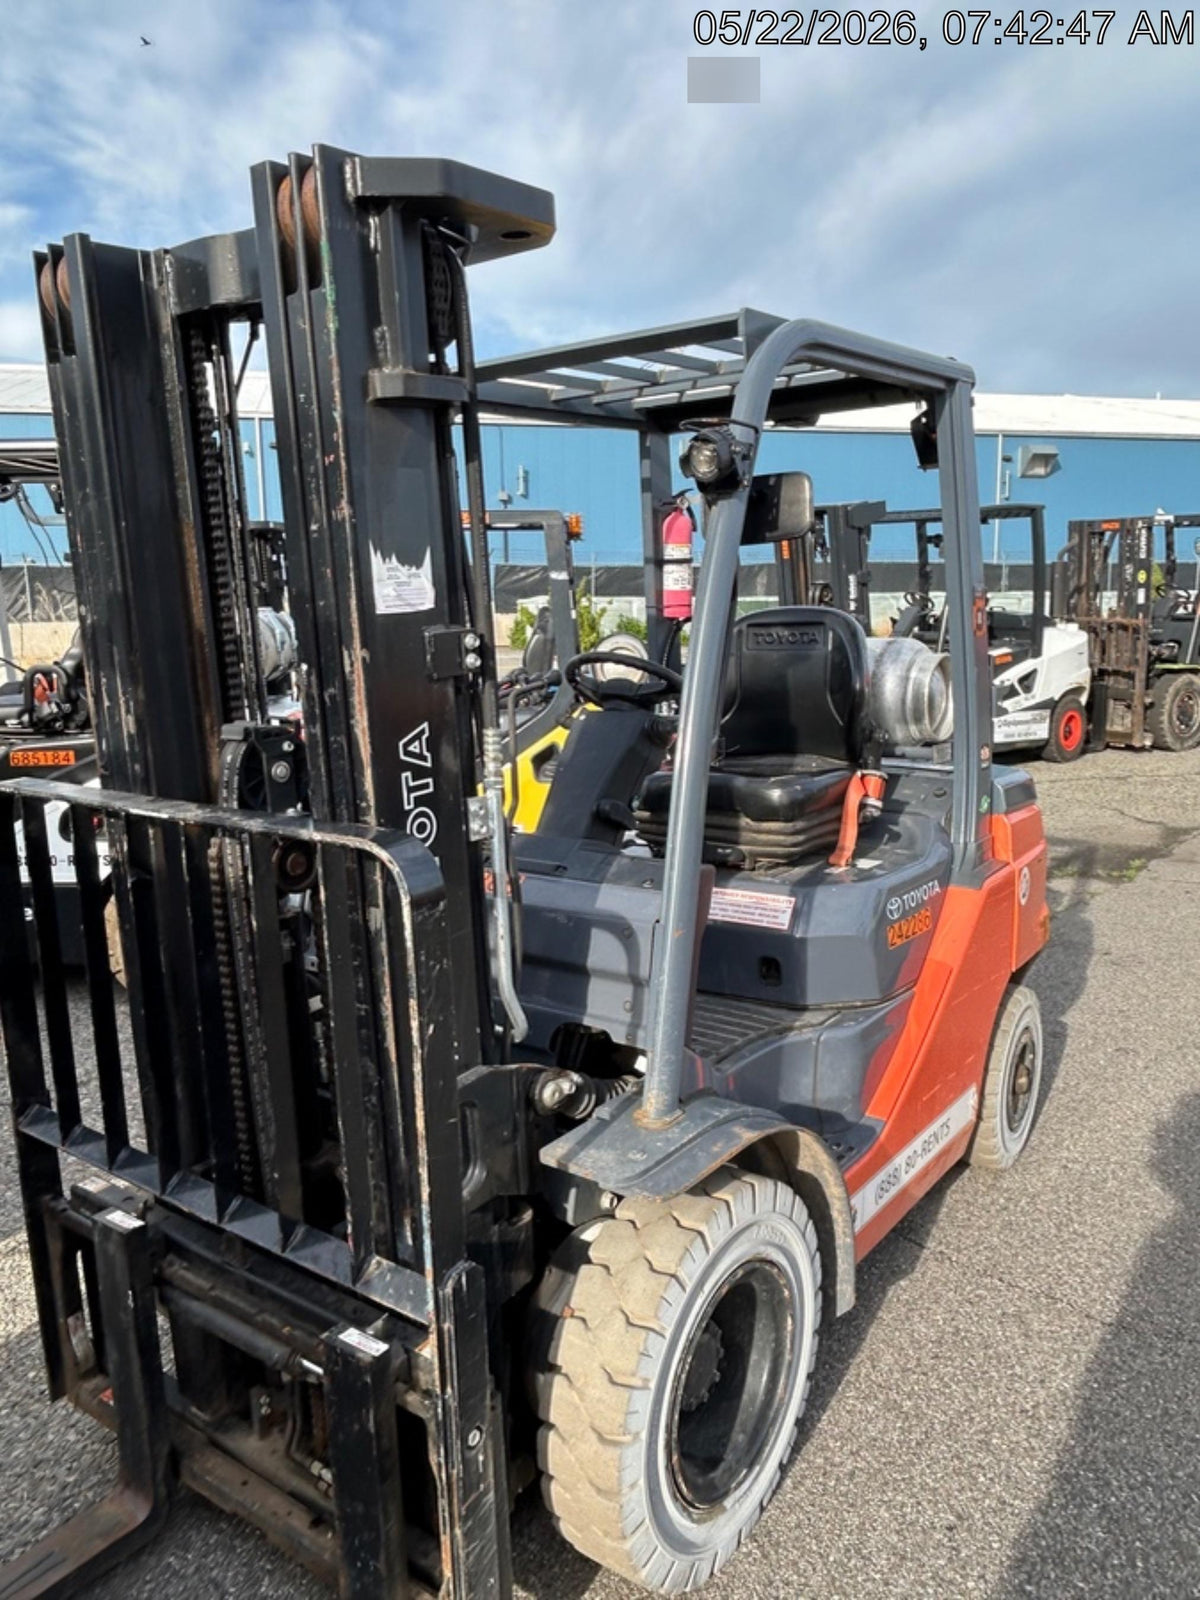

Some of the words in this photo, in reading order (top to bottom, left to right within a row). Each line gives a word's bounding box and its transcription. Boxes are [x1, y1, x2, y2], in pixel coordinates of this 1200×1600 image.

[752, 631, 819, 645] TOYOTA
[11, 751, 72, 766] 685184
[902, 879, 941, 911] TOYOTA
[888, 907, 931, 948] 242286
[874, 1163, 903, 1206] (888)
[904, 1117, 951, 1175] 80-RENTS
